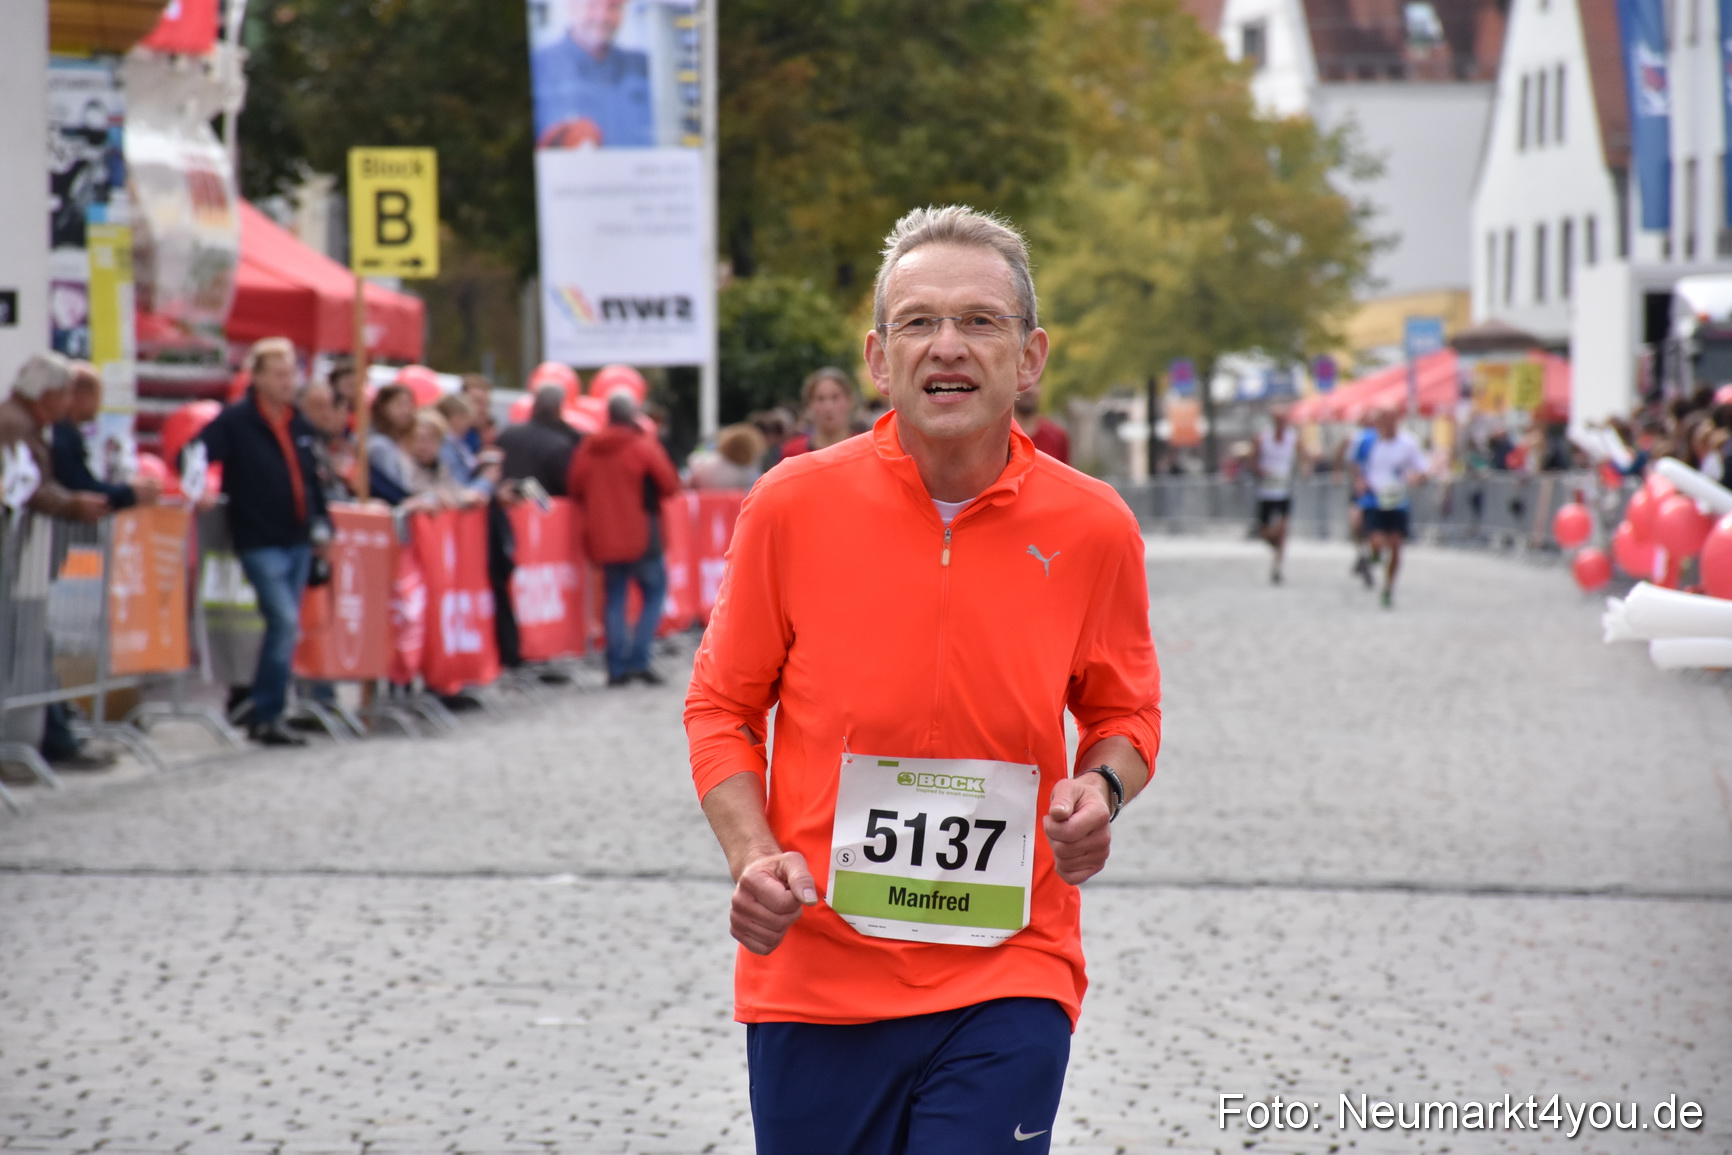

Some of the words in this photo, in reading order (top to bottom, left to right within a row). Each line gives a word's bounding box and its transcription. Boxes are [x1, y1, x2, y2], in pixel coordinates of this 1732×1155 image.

[361, 155, 423, 178] Block
[376, 189, 414, 246] B
[917, 773, 985, 793] BOCK
[863, 808, 1007, 872] 5137
[842, 852, 850, 863] S
[888, 885, 970, 912] Manfred
